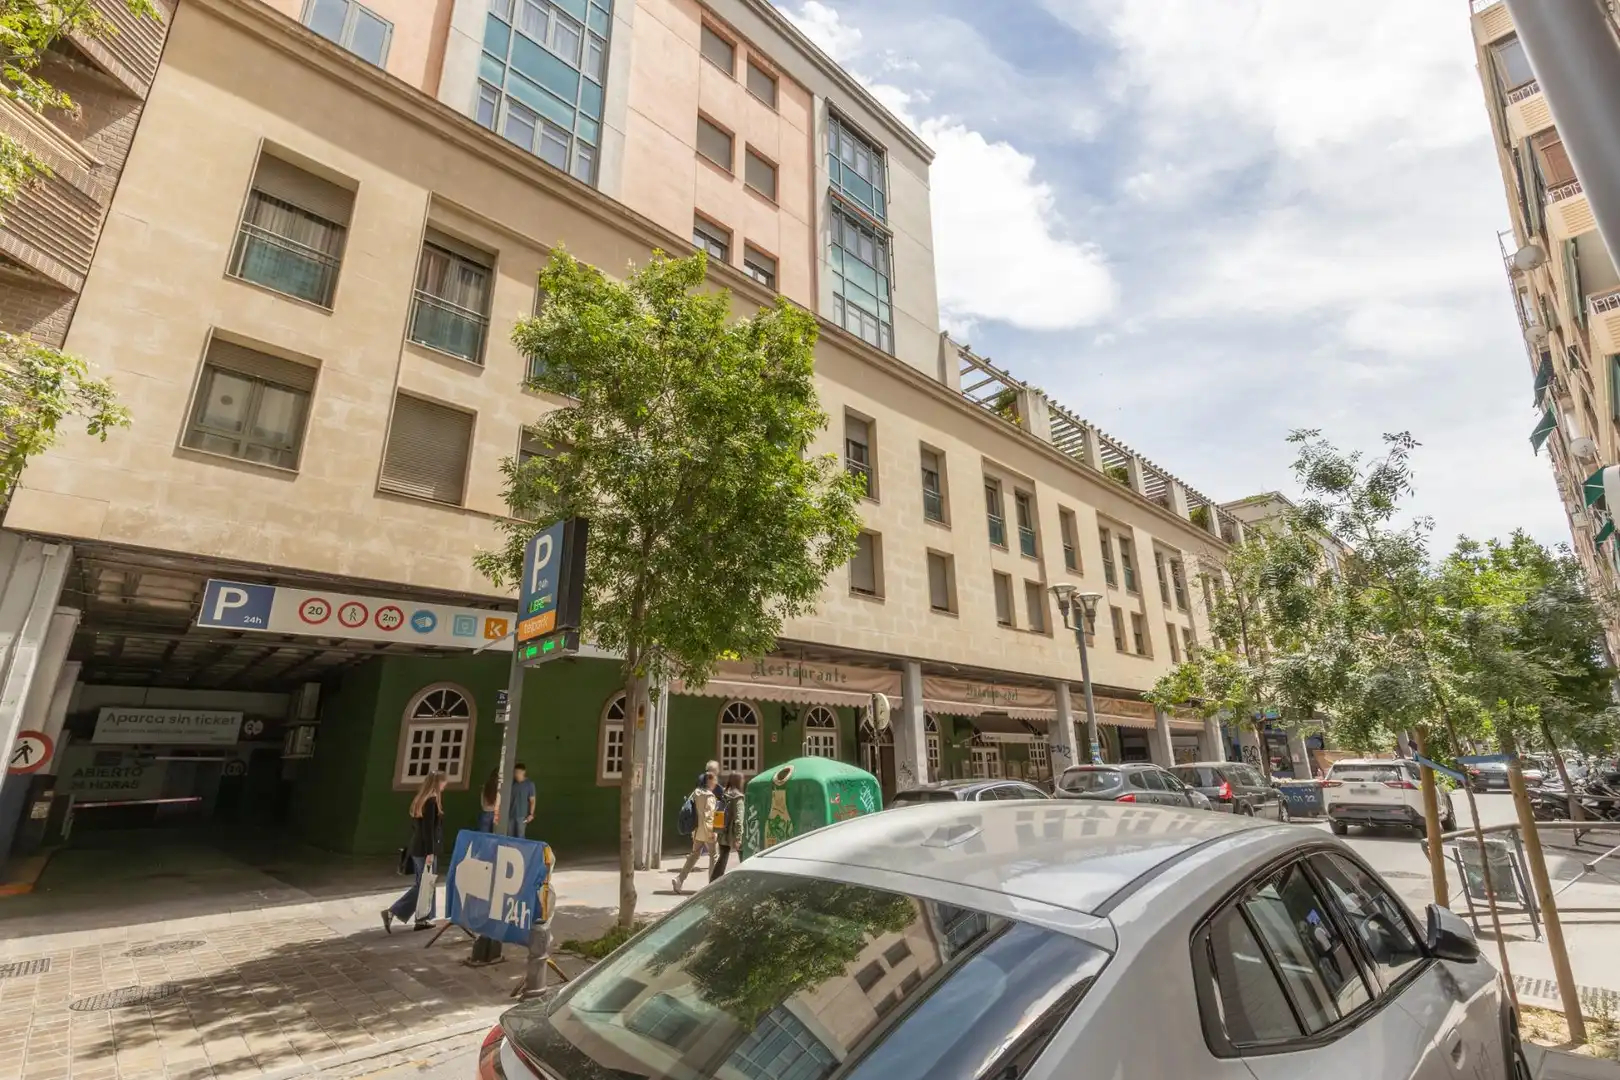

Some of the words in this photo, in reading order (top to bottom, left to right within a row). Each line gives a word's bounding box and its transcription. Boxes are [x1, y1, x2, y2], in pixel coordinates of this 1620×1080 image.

[531, 534, 553, 594] P
[212, 586, 249, 621] P
[308, 606, 323, 616] 20
[382, 613, 398, 622] 2m
[243, 615, 262, 624] 24h
[751, 659, 847, 683] Restaurante
[104, 712, 166, 726] Aparca
[168, 713, 192, 725] sin
[195, 714, 237, 726] ticket
[72, 767, 143, 777] ABIERTO
[89, 779, 139, 789] HORAS
[488, 845, 525, 921] P
[504, 897, 531, 930] 24h
